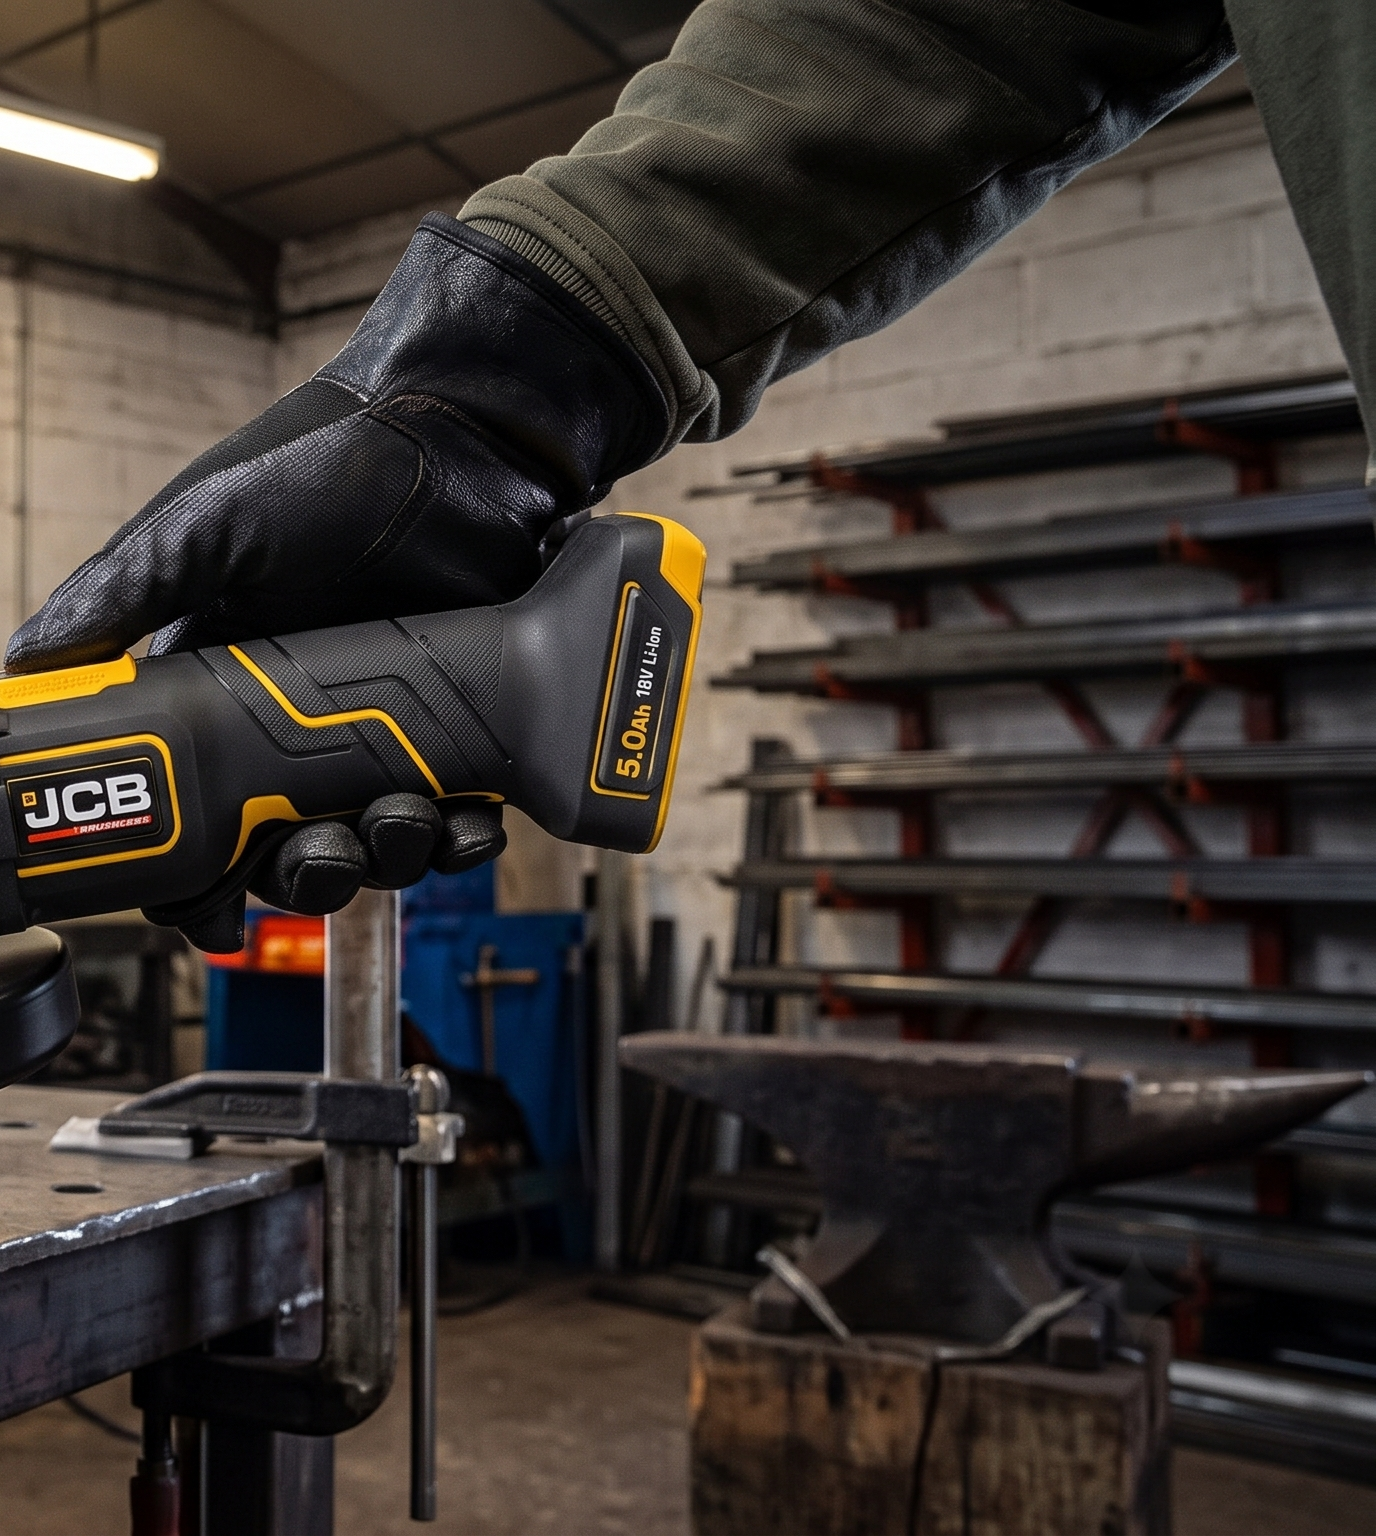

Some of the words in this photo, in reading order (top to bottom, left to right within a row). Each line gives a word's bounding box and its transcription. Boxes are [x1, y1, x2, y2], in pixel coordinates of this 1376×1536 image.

[642, 626, 662, 665] Li-Ion
[635, 667, 654, 698] 18V
[616, 704, 652, 778] 5.0Ah
[25, 773, 152, 829] JCB
